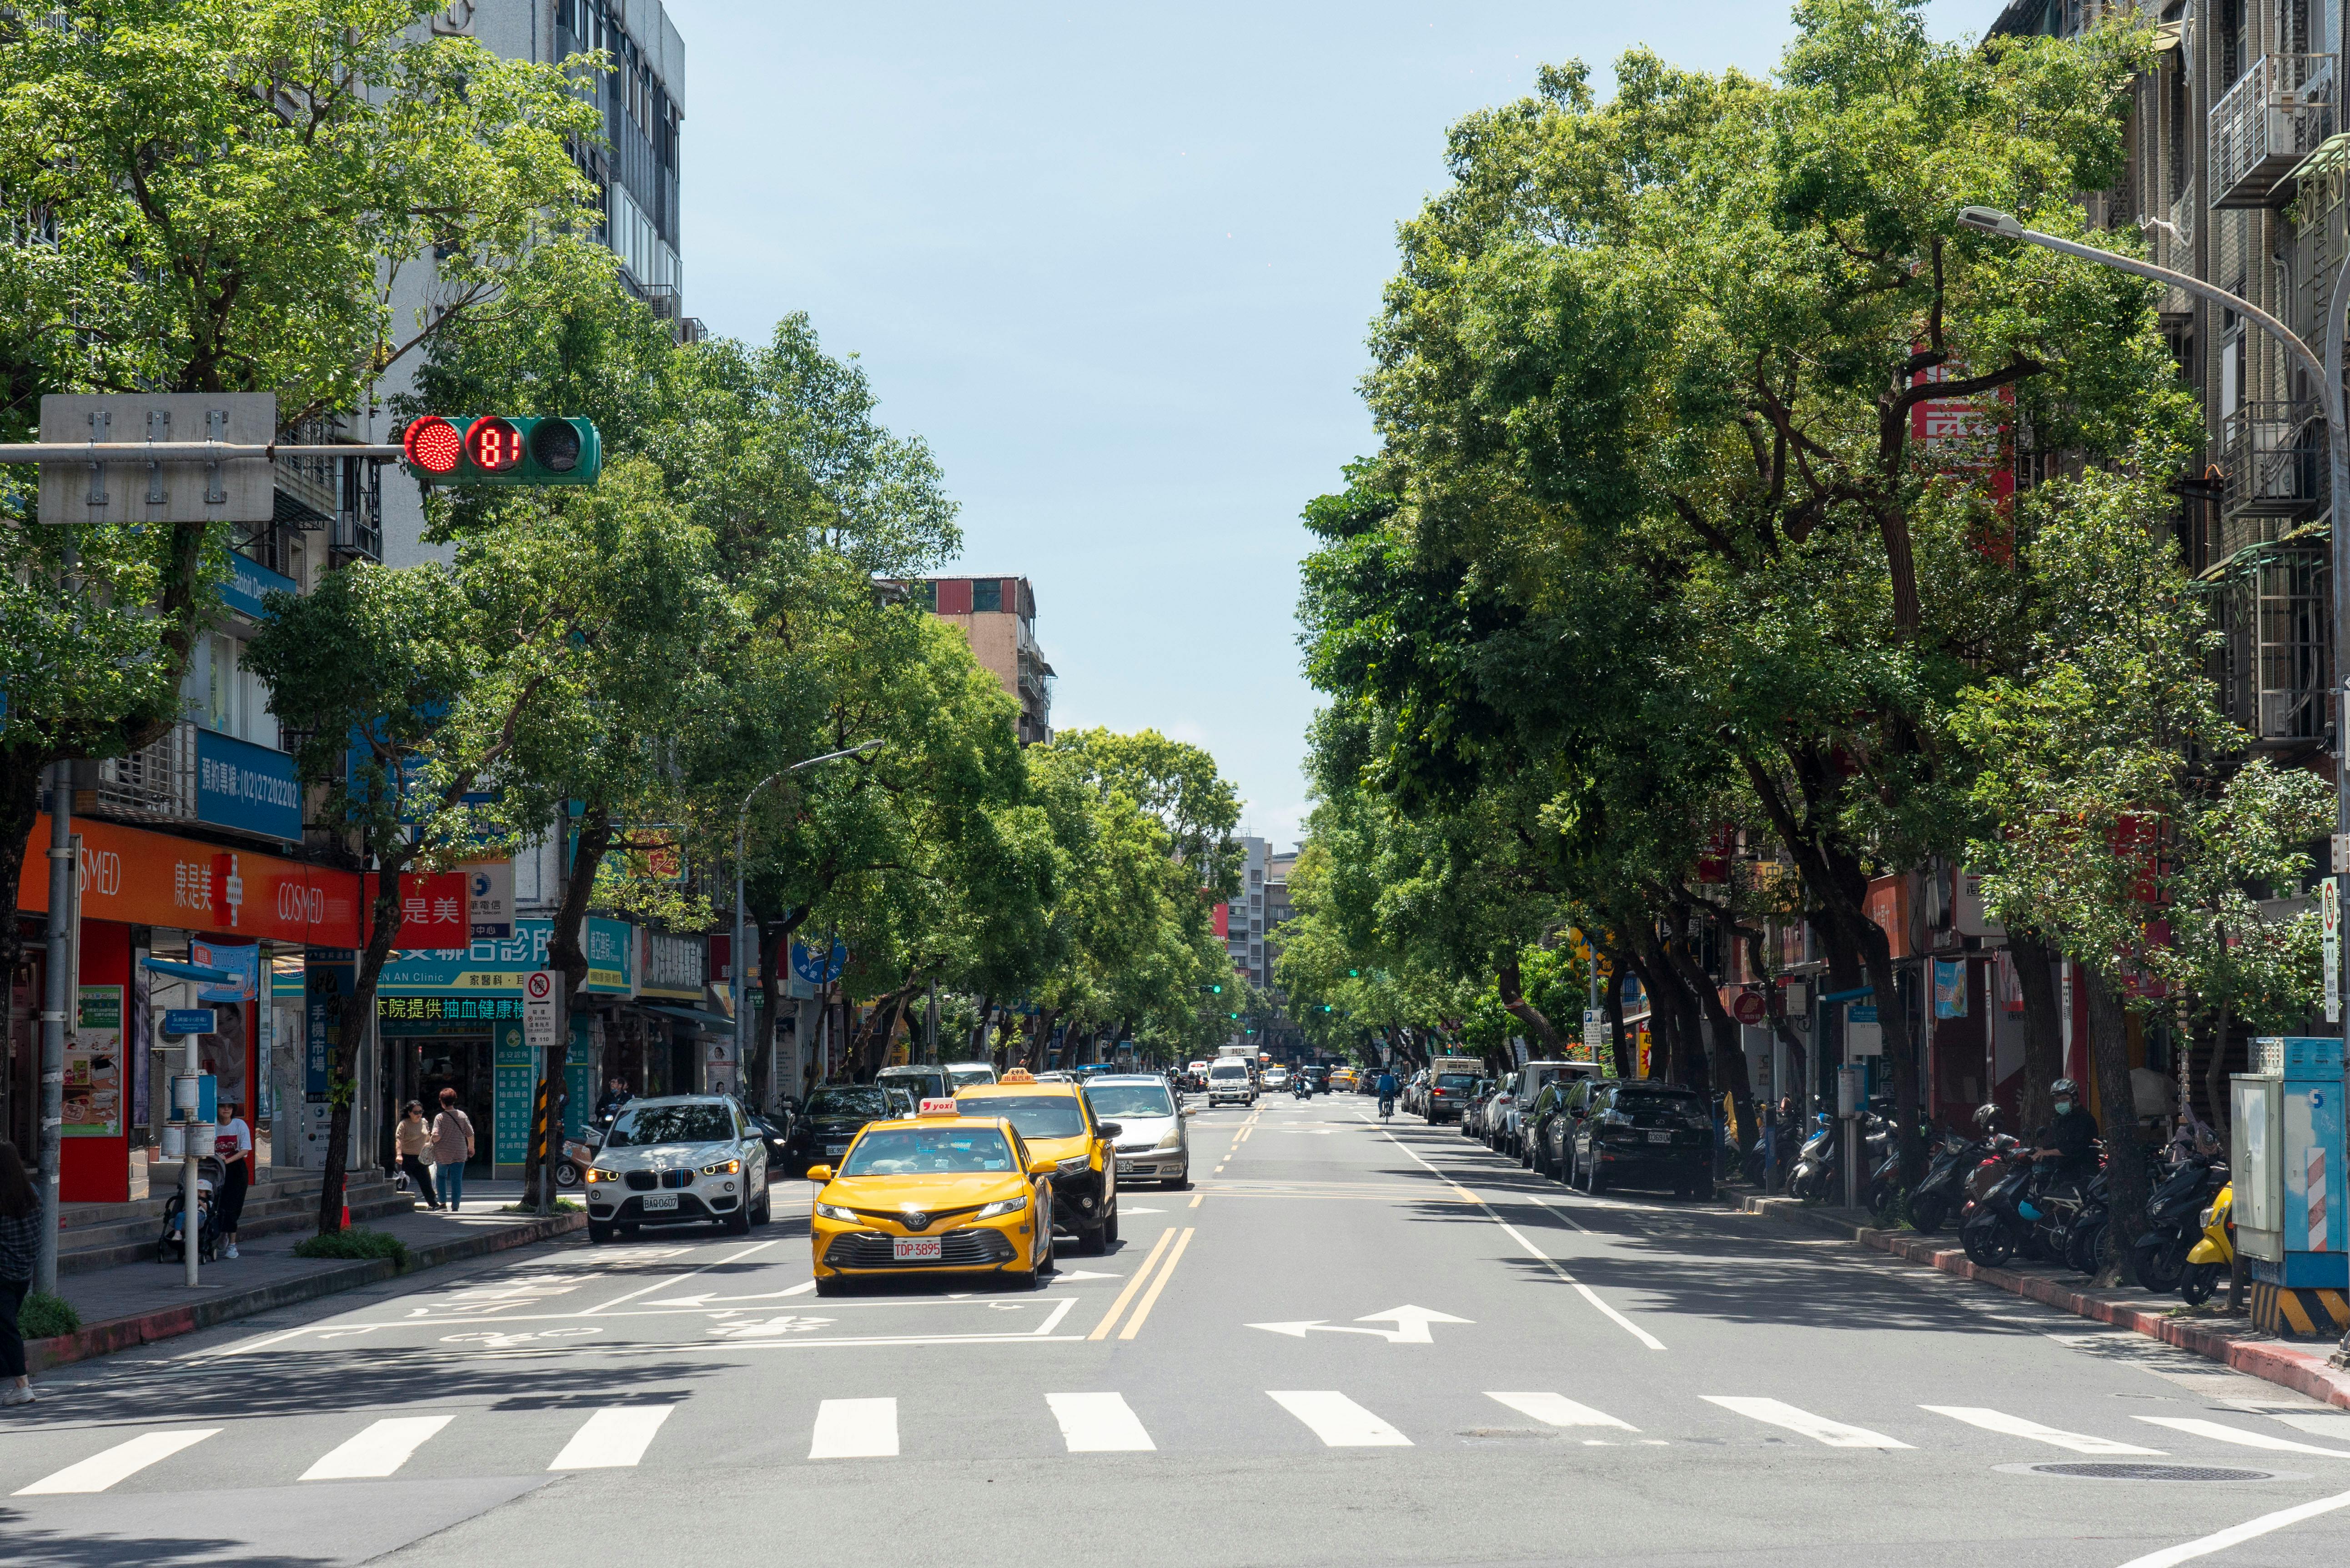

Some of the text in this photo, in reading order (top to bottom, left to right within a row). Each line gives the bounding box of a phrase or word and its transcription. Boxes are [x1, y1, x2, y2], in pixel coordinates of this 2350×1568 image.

[482, 429, 519, 467] 81
[175, 860, 212, 910] 康是美
[278, 882, 324, 924] COSMED
[402, 896, 459, 924] 是美
[394, 973, 409, 981] AN
[413, 972, 444, 982] Clinic
[311, 1004, 326, 1072] 手機市場
[932, 1101, 954, 1111] yoxi
[894, 1243, 940, 1256] TDP-3895
